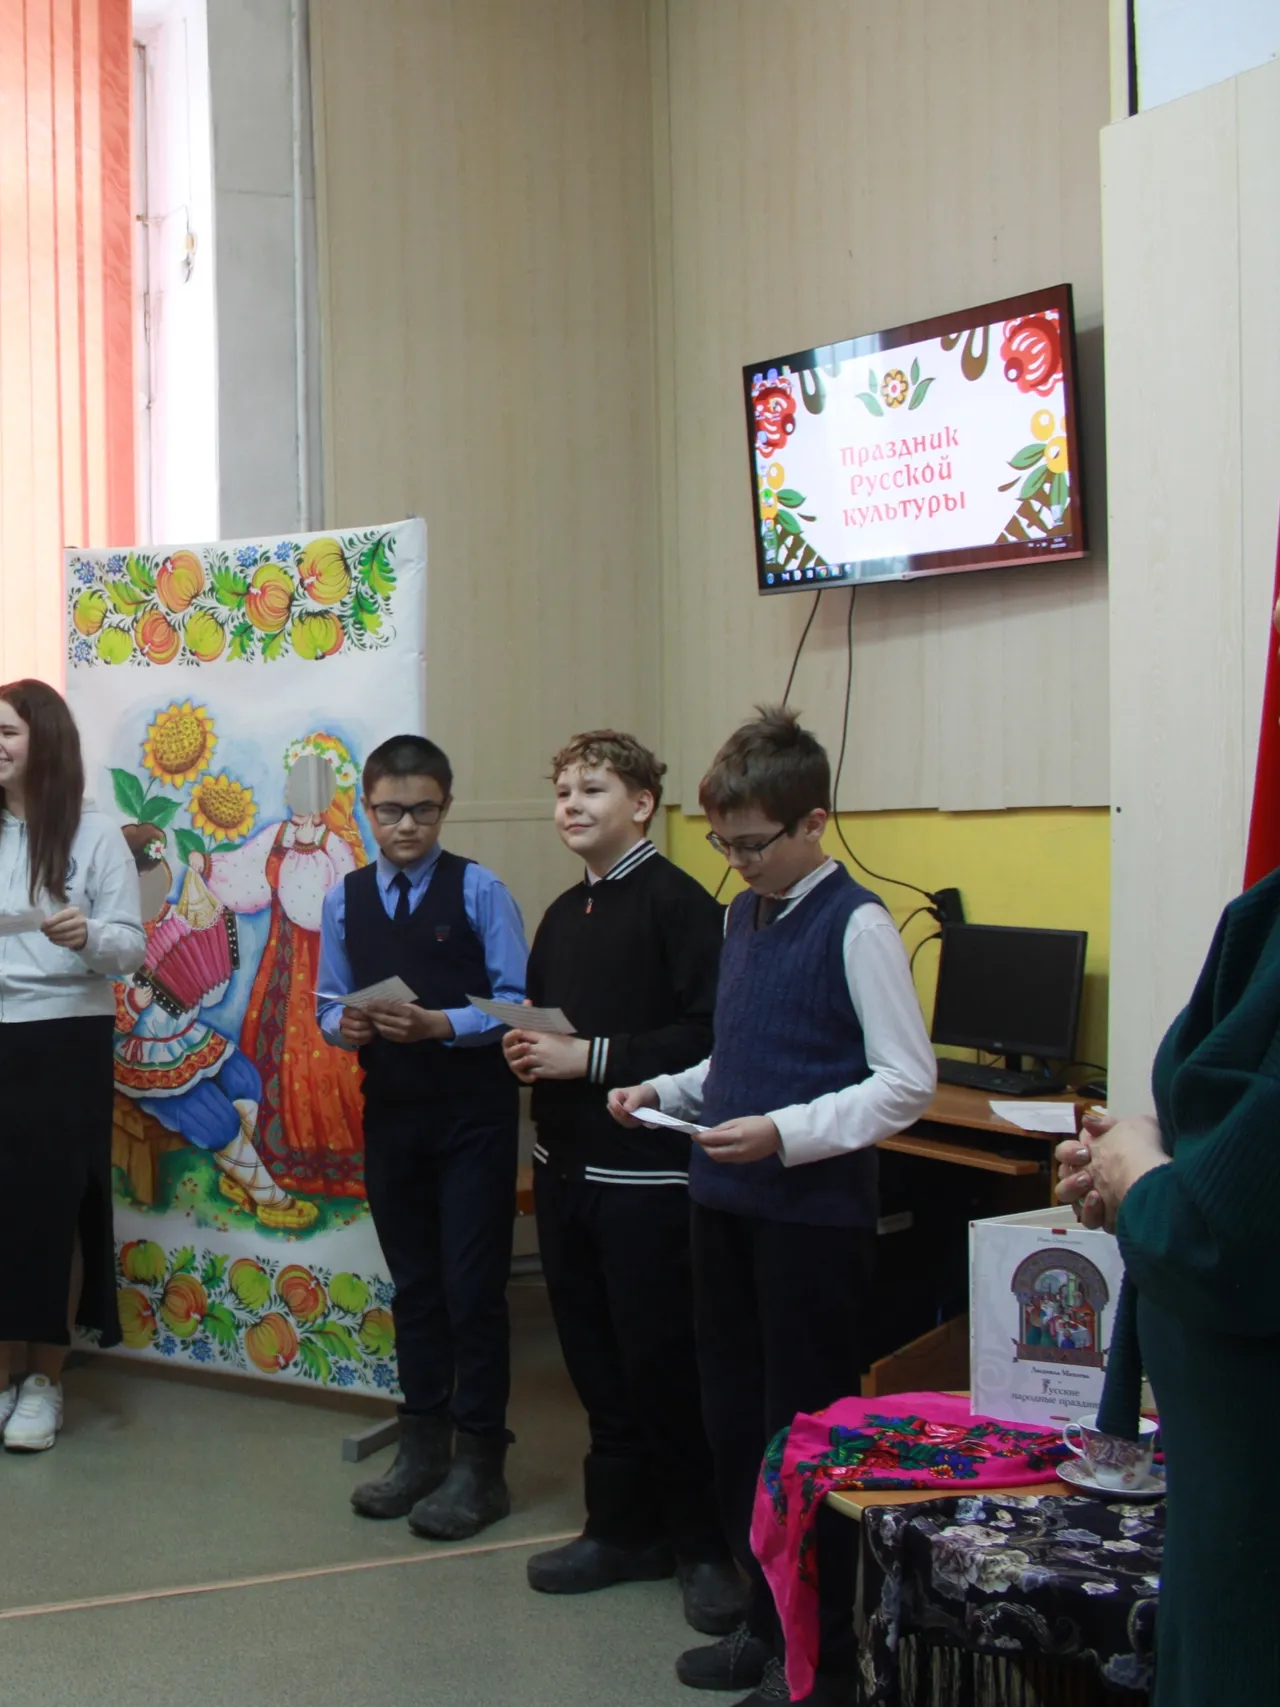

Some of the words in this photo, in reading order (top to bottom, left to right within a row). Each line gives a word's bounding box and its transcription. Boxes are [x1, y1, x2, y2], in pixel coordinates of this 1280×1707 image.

[839, 425, 960, 467] Праздник
[850, 454, 952, 498] Русской
[842, 490, 966, 528] культуры
[1011, 1392, 1056, 1404] народные
[1058, 1398, 1100, 1409] праздни
[1041, 1378, 1080, 1396] Русские
